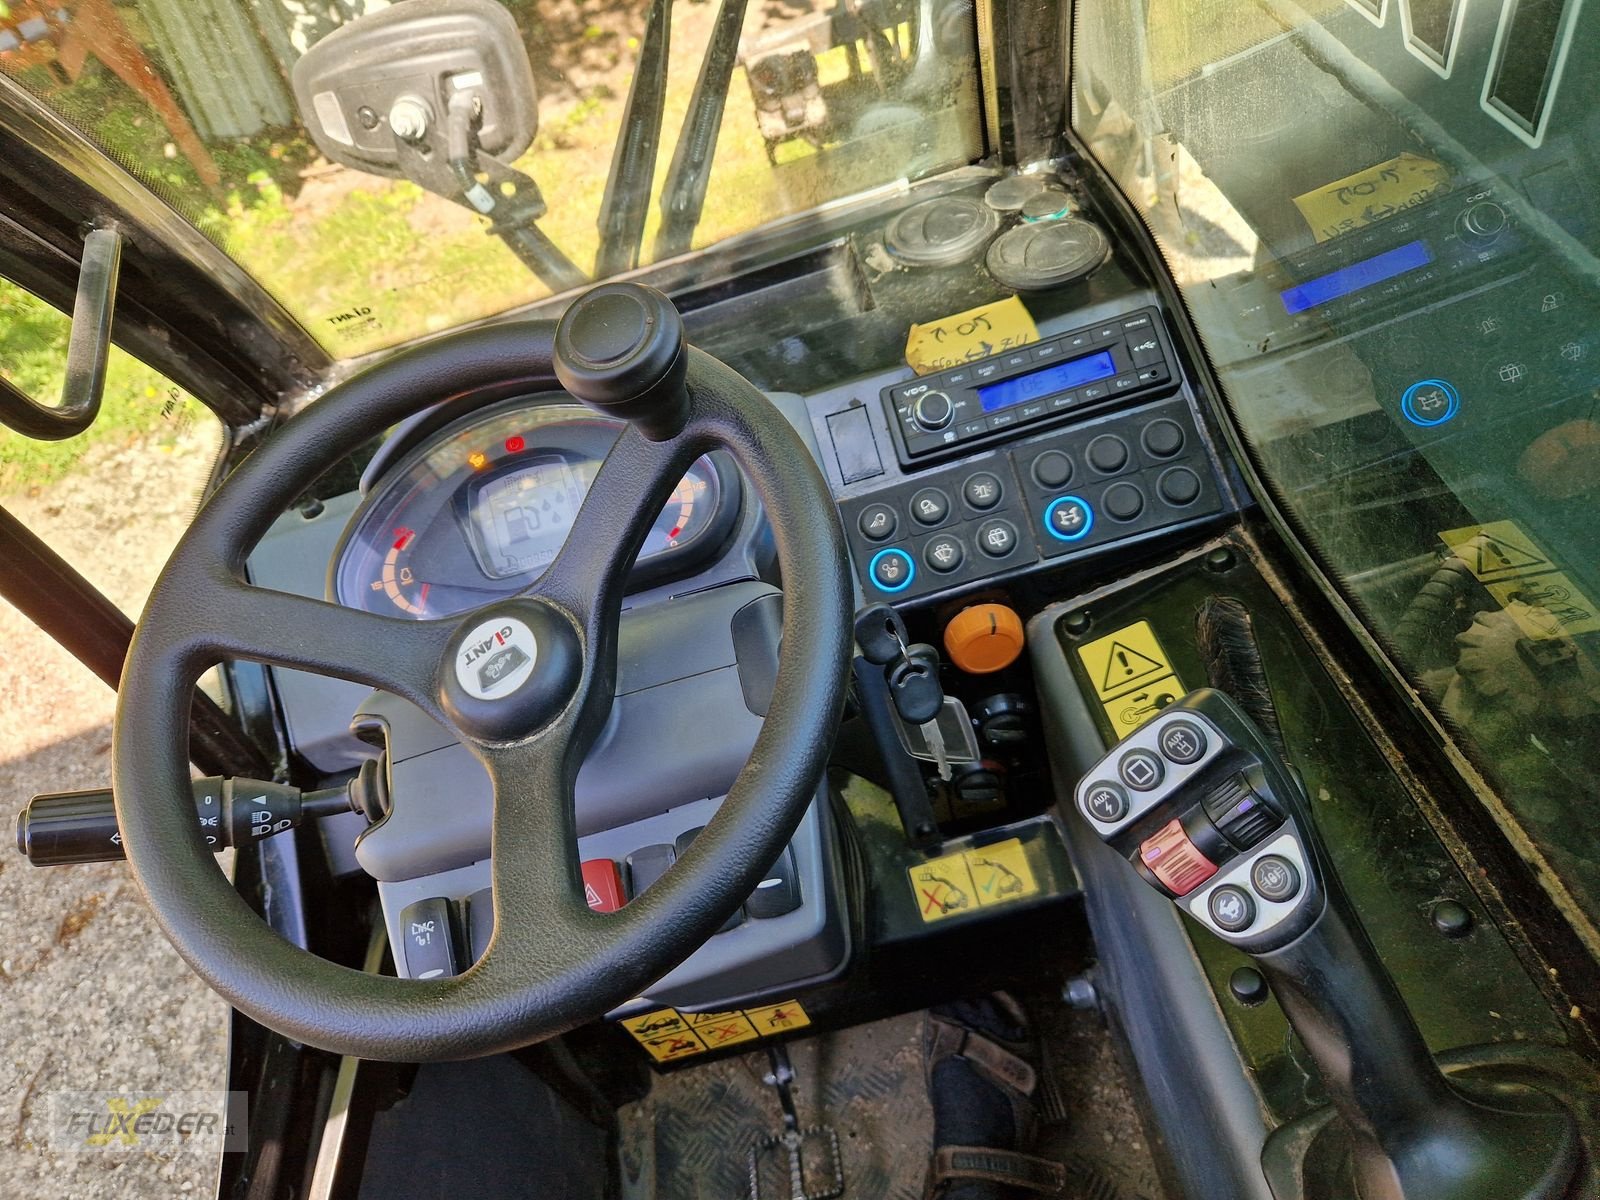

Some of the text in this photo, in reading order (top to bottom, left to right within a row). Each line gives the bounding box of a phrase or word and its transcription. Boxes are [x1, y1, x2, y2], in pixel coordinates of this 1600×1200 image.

[903, 384, 928, 397] VDO
[1167, 731, 1185, 750] AUX
[1093, 791, 1110, 807] AUX
